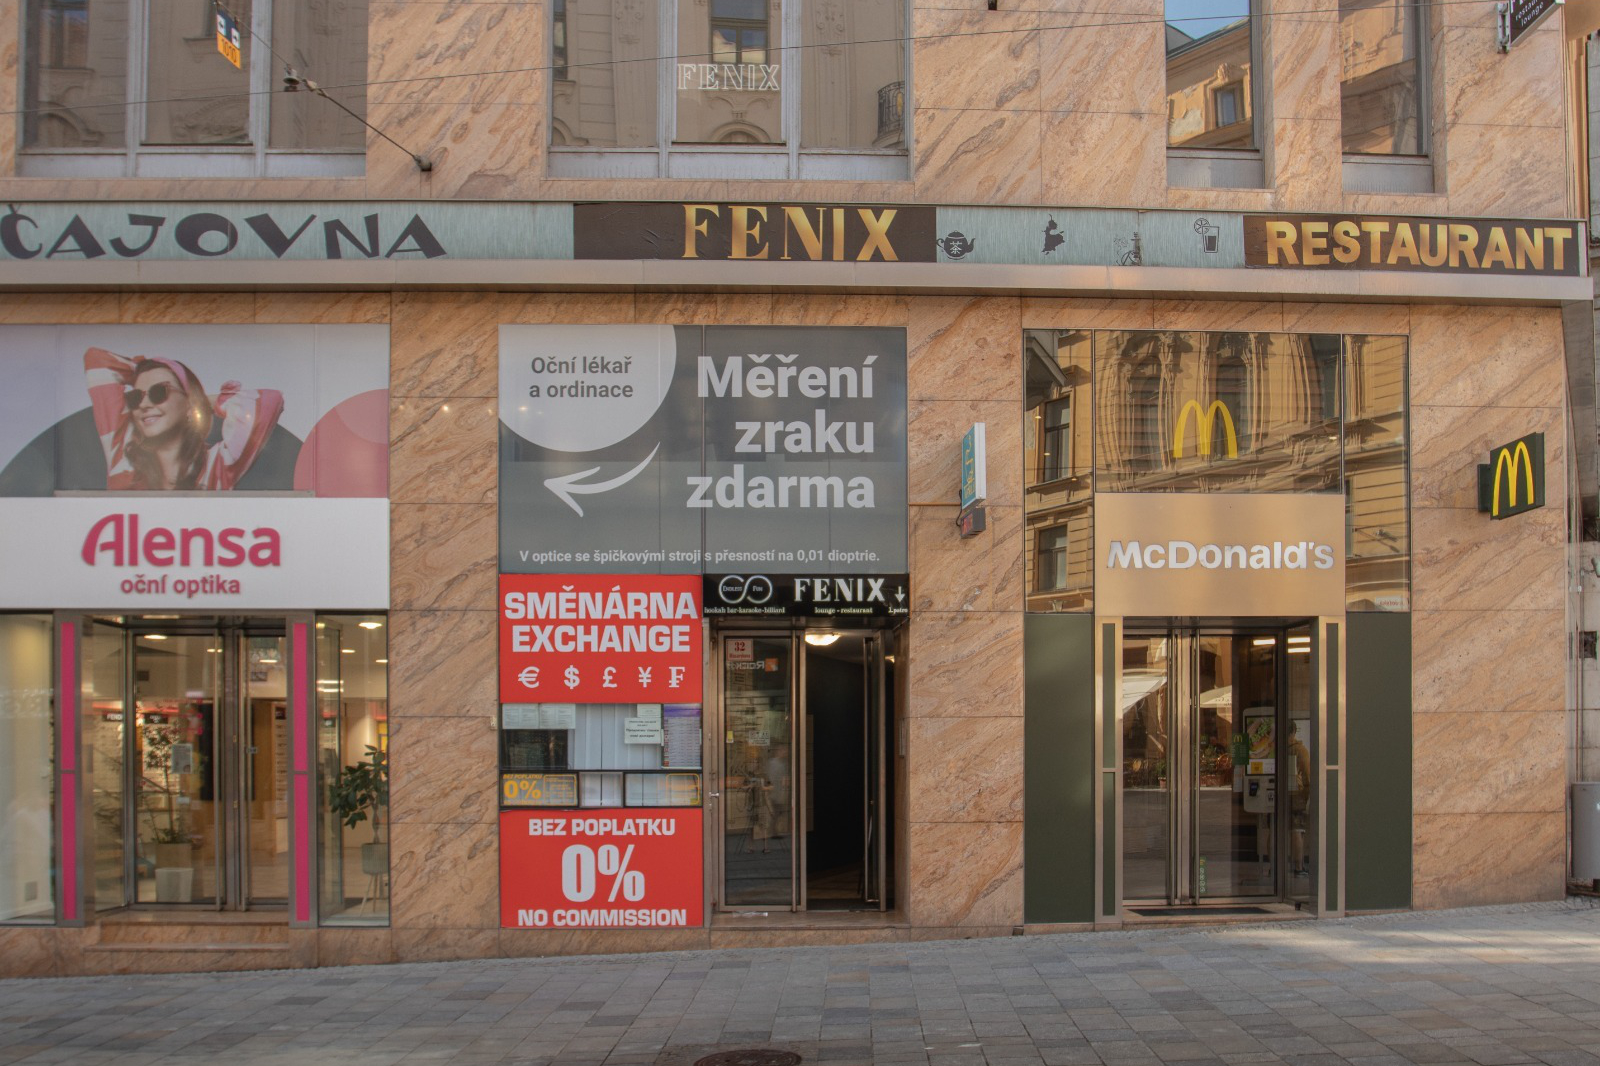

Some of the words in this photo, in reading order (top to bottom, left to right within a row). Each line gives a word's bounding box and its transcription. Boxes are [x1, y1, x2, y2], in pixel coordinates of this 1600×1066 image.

[1521, 1, 1544, 27] lounge
[677, 63, 780, 91] FENIX
[0, 204, 447, 260] ČAJOVNA
[681, 204, 899, 261] FENIX
[1265, 220, 1573, 270] RESTAURANT
[531, 356, 577, 374] Oční
[582, 356, 632, 374] lékař
[697, 353, 879, 398] Měření
[529, 383, 541, 398] a
[546, 380, 634, 398] ordinace
[734, 409, 875, 453] zraku
[686, 464, 876, 508] zdarma
[80, 513, 281, 567] Alensa
[519, 551, 529, 562] V
[532, 550, 572, 564] optice
[575, 552, 590, 562] se
[593, 550, 665, 564] špičkovými
[668, 550, 700, 564] stroji
[704, 552, 712, 562] s
[715, 550, 775, 564] přesností
[778, 552, 794, 562] na
[797, 550, 823, 563] 0,01
[828, 550, 880, 564] dioptrie.
[1106, 540, 1335, 570] McDonald's
[120, 574, 168, 594] oční
[173, 574, 241, 599] optika
[794, 578, 886, 602] FENIX
[504, 584, 698, 619] SMĚNÁRNA
[814, 606, 836, 615] lounge
[840, 606, 873, 614] restaurant
[512, 625, 690, 652] EXCHANGE
[734, 641, 746, 651] 32
[503, 780, 542, 799] 0%
[529, 818, 567, 836] BEZ
[571, 818, 676, 836] POPLATKU
[561, 844, 646, 903] 0%
[517, 909, 548, 926] NO
[552, 909, 687, 926] COMMISSION
